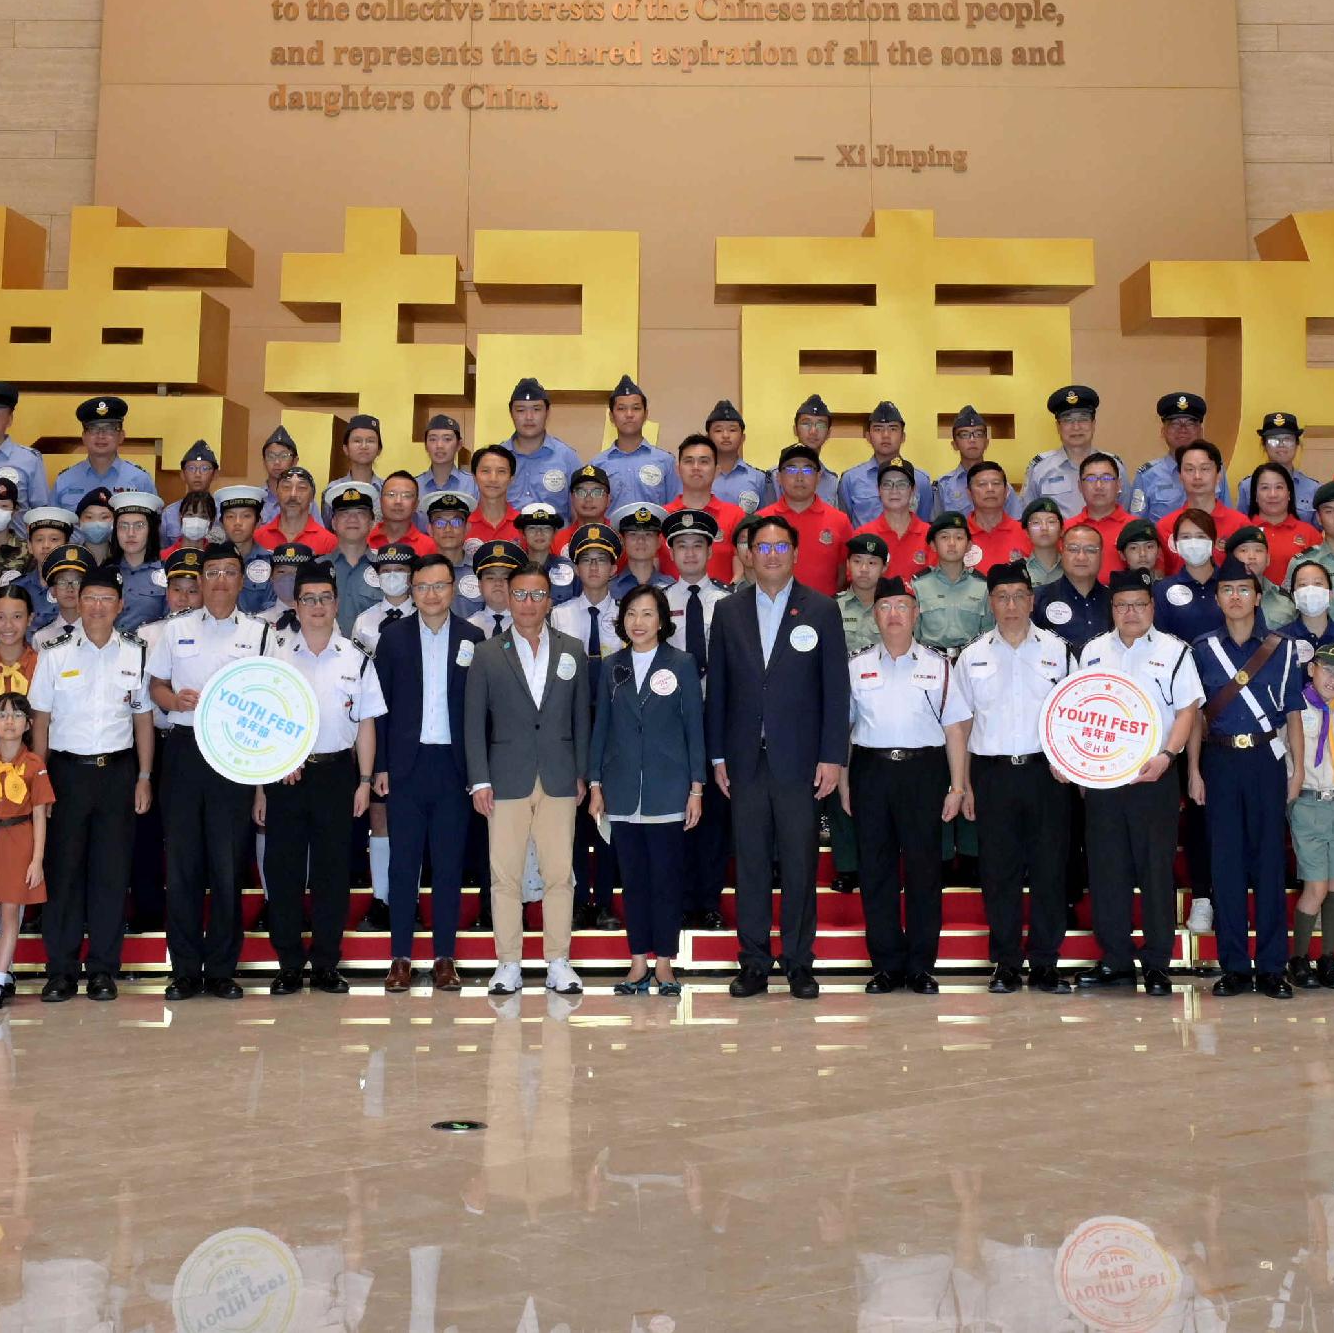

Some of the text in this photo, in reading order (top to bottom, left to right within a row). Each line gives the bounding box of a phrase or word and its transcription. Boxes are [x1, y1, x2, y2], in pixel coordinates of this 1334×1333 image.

[270, 38, 1065, 71] and represents the shared aspiration of all the sons and
[269, 81, 558, 115] daughters of China.
[836, 144, 866, 168] Xi
[872, 144, 968, 172] Jinping
[218, 688, 305, 738] YOUTH FEST
[1057, 706, 1149, 736] YOUTH FEST
